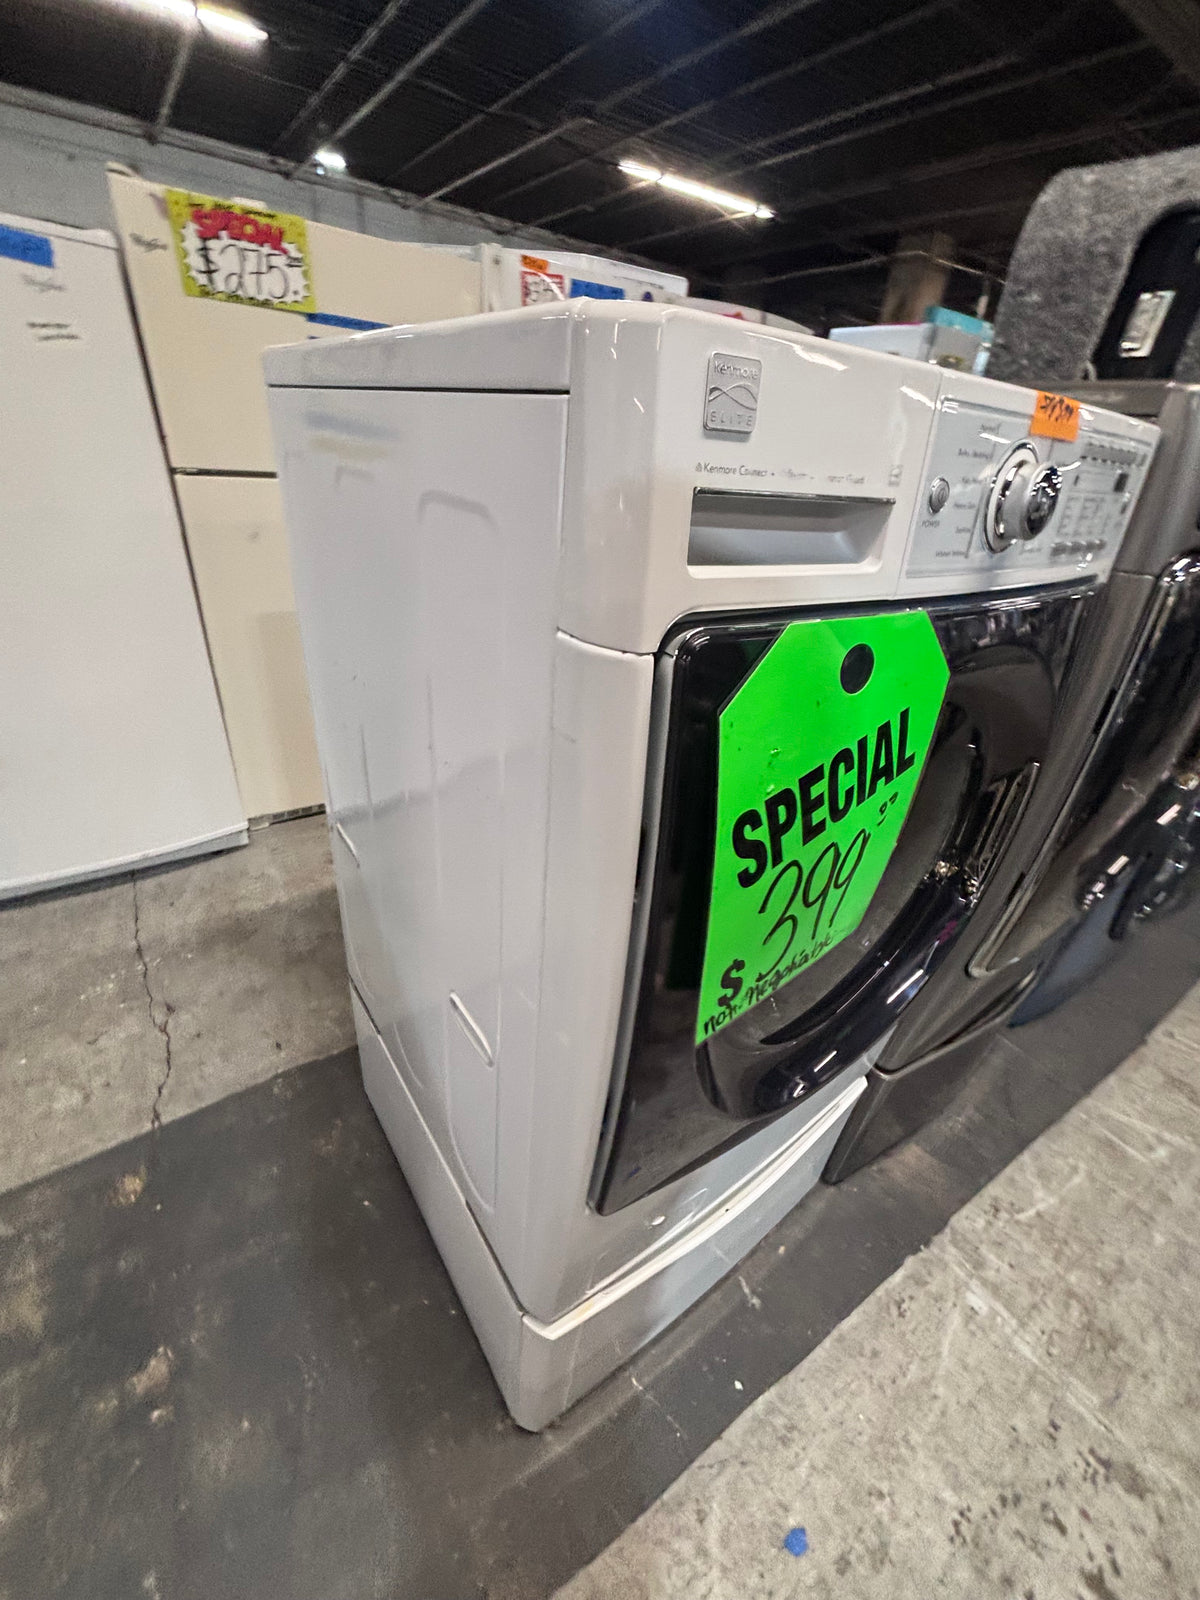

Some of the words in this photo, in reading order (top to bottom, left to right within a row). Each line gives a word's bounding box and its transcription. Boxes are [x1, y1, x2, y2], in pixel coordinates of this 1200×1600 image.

[713, 361, 760, 380] Kenmore
[710, 410, 754, 426] ELITE
[703, 462, 737, 475] Kenmore
[732, 707, 916, 889] SPECIAL
